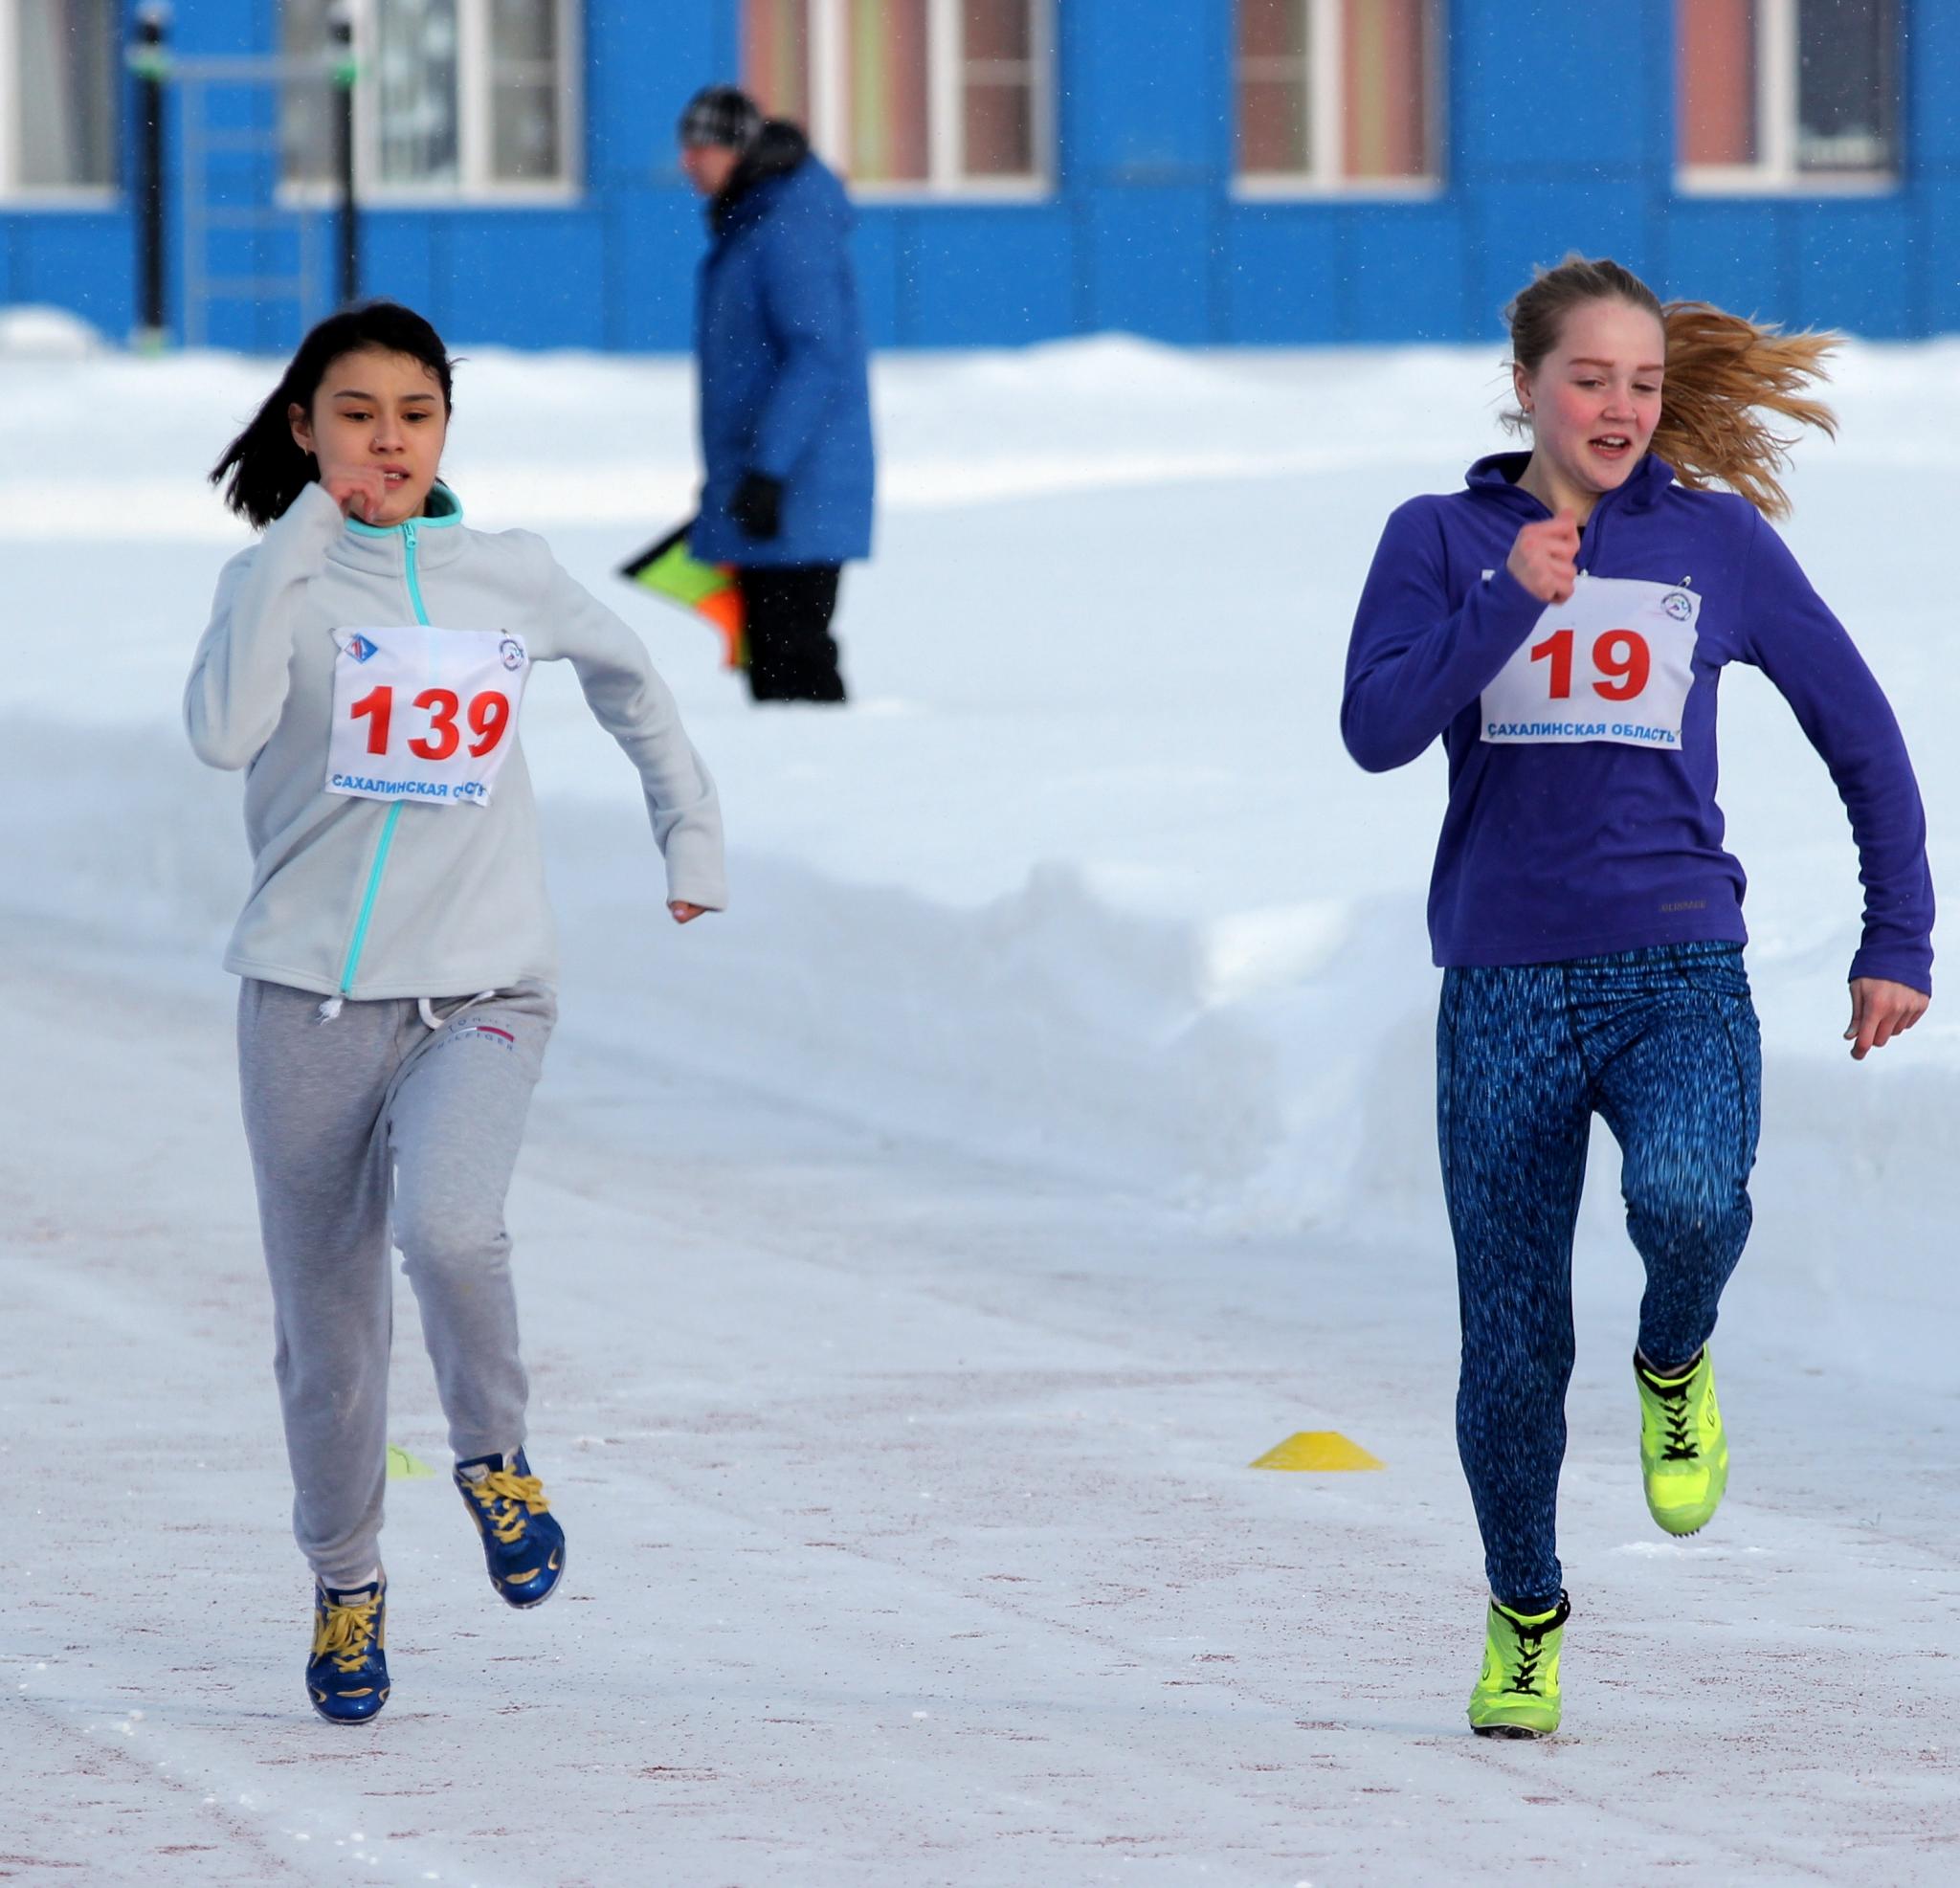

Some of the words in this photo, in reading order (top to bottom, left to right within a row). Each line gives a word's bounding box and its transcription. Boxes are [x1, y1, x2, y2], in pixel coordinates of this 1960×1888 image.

[1530, 629, 1651, 701] 19
[350, 685, 510, 761] 139
[1487, 722, 1606, 739] САХАЛИНСКАЯ
[1612, 723, 1676, 743] ОБЛАСТЬ
[332, 773, 448, 797] САХАЛИНСКАЯ
